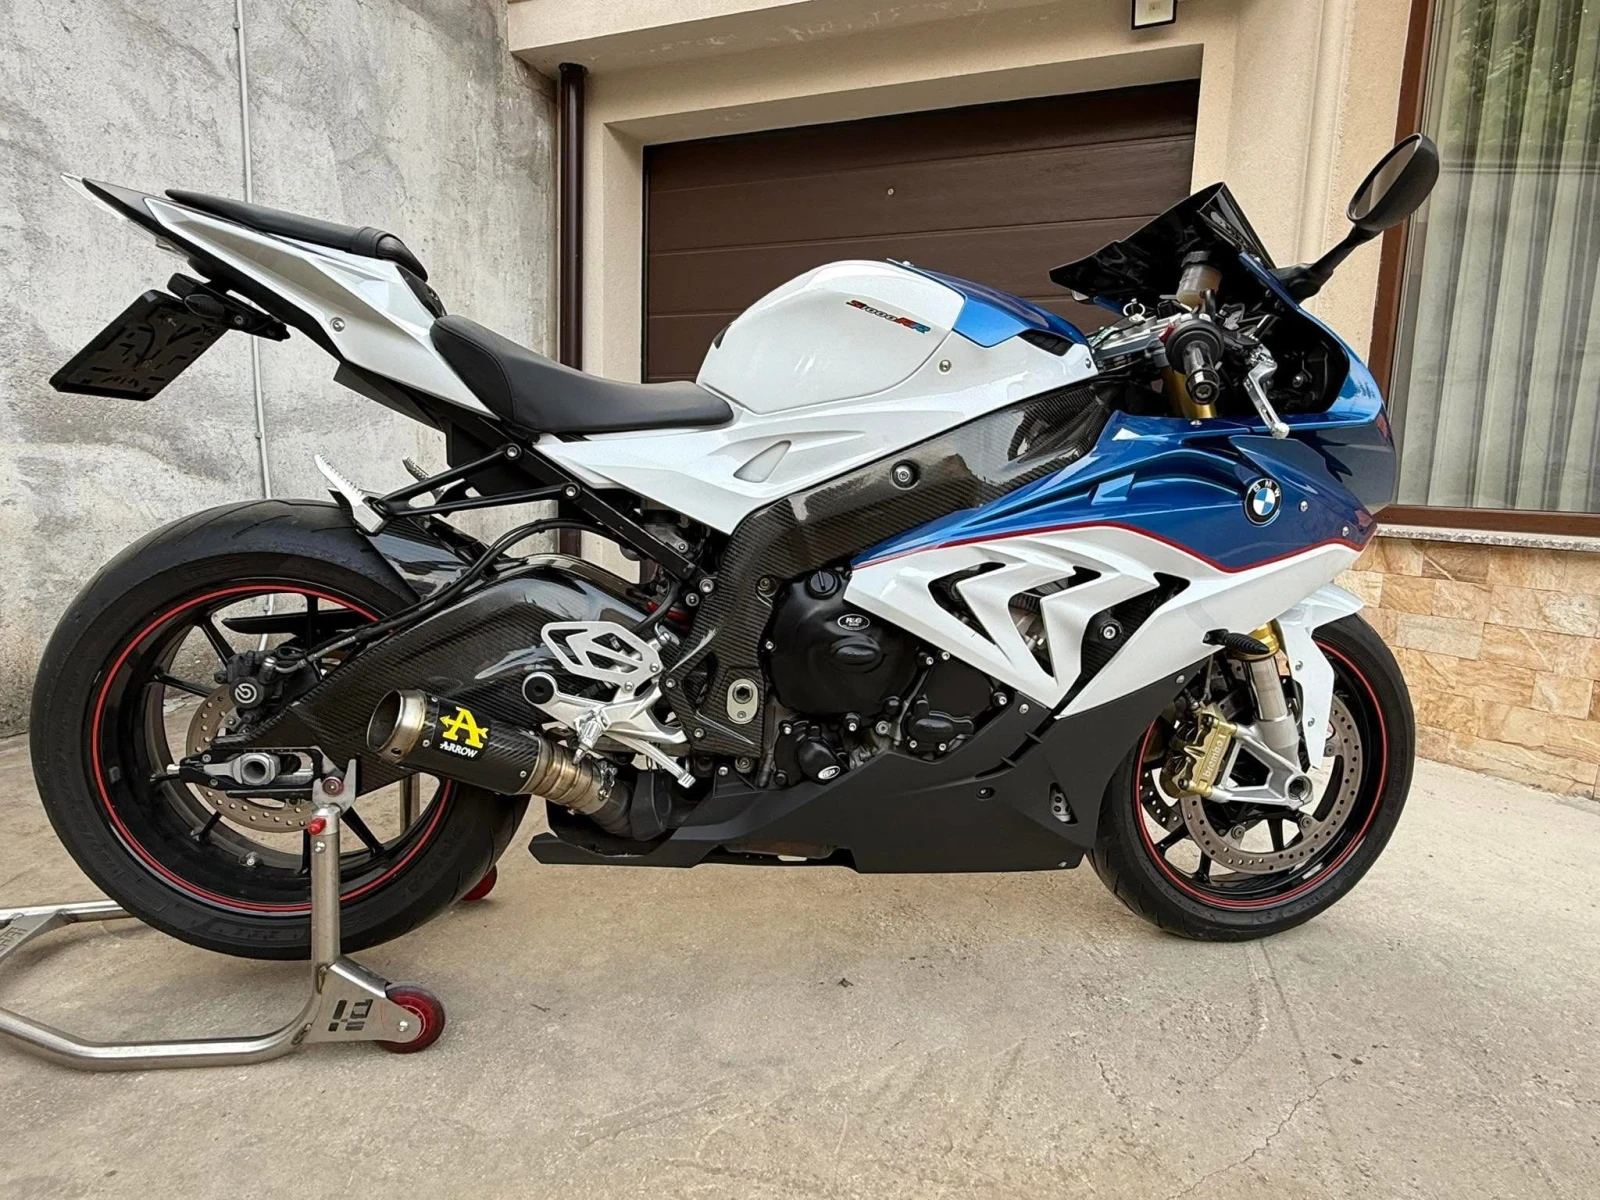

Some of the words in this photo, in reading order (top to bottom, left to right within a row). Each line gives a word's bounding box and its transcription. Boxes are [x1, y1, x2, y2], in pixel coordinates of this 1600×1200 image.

[1252, 480, 1280, 498] BMW
[439, 741, 478, 758] ARROW
[1202, 740, 1223, 778] brembo
